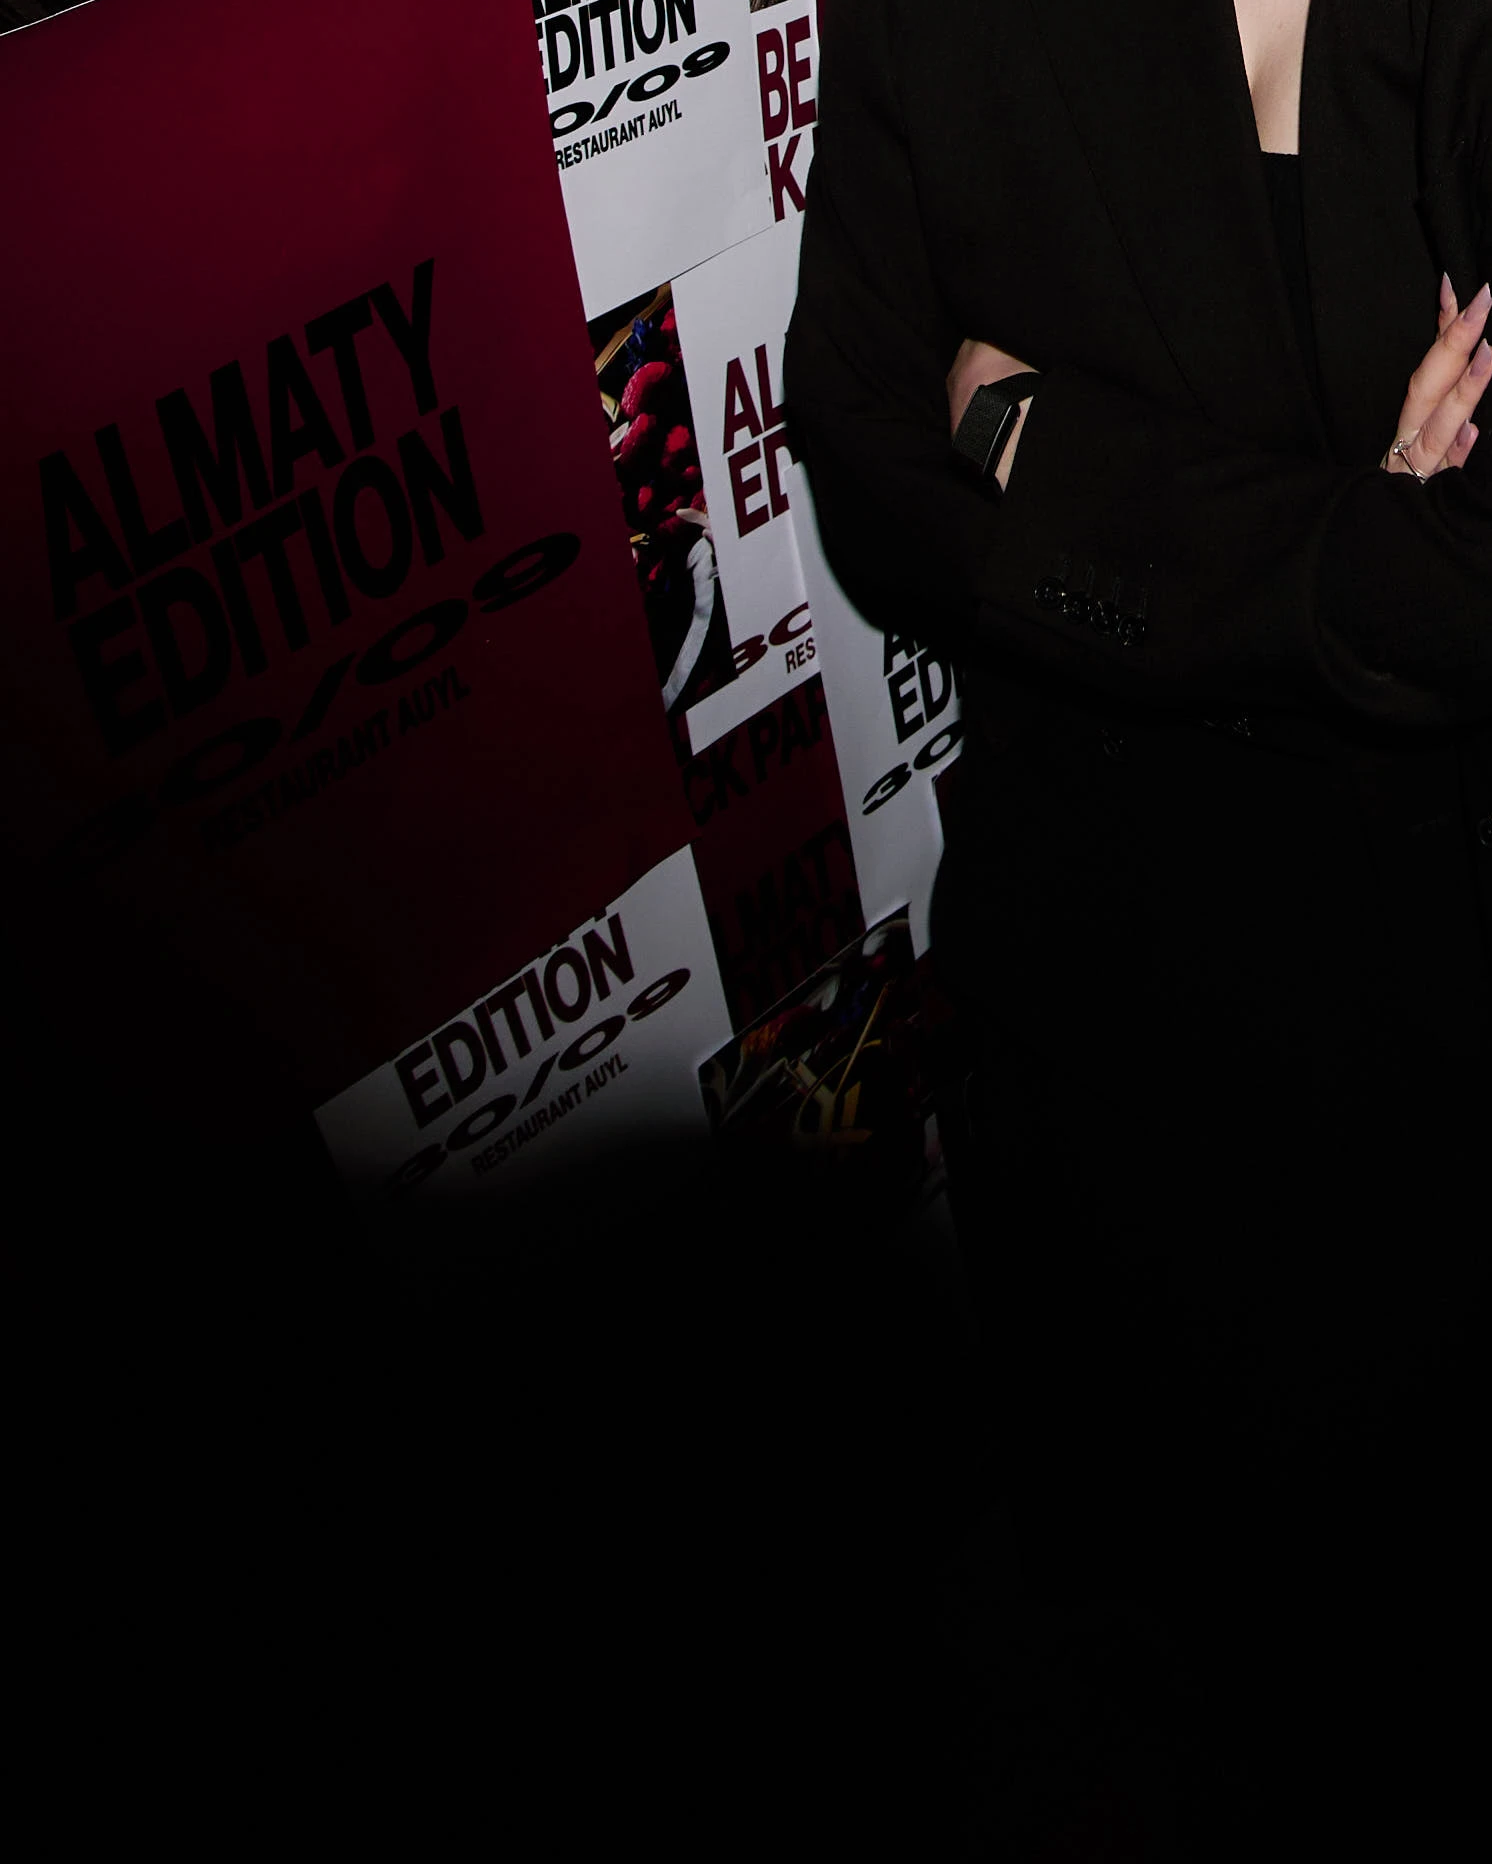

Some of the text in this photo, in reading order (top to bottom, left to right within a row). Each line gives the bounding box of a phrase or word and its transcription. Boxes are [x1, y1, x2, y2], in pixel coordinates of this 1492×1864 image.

[550, 41, 730, 139] 0/09
[556, 99, 682, 170] RESTAURANT AUYL
[39, 257, 438, 621] ALMATY
[69, 406, 485, 759] EDITION
[385, 968, 690, 1200] 30/09
[394, 913, 635, 1129] EDITION
[471, 1055, 628, 1176] RESTAURANT AUYL
